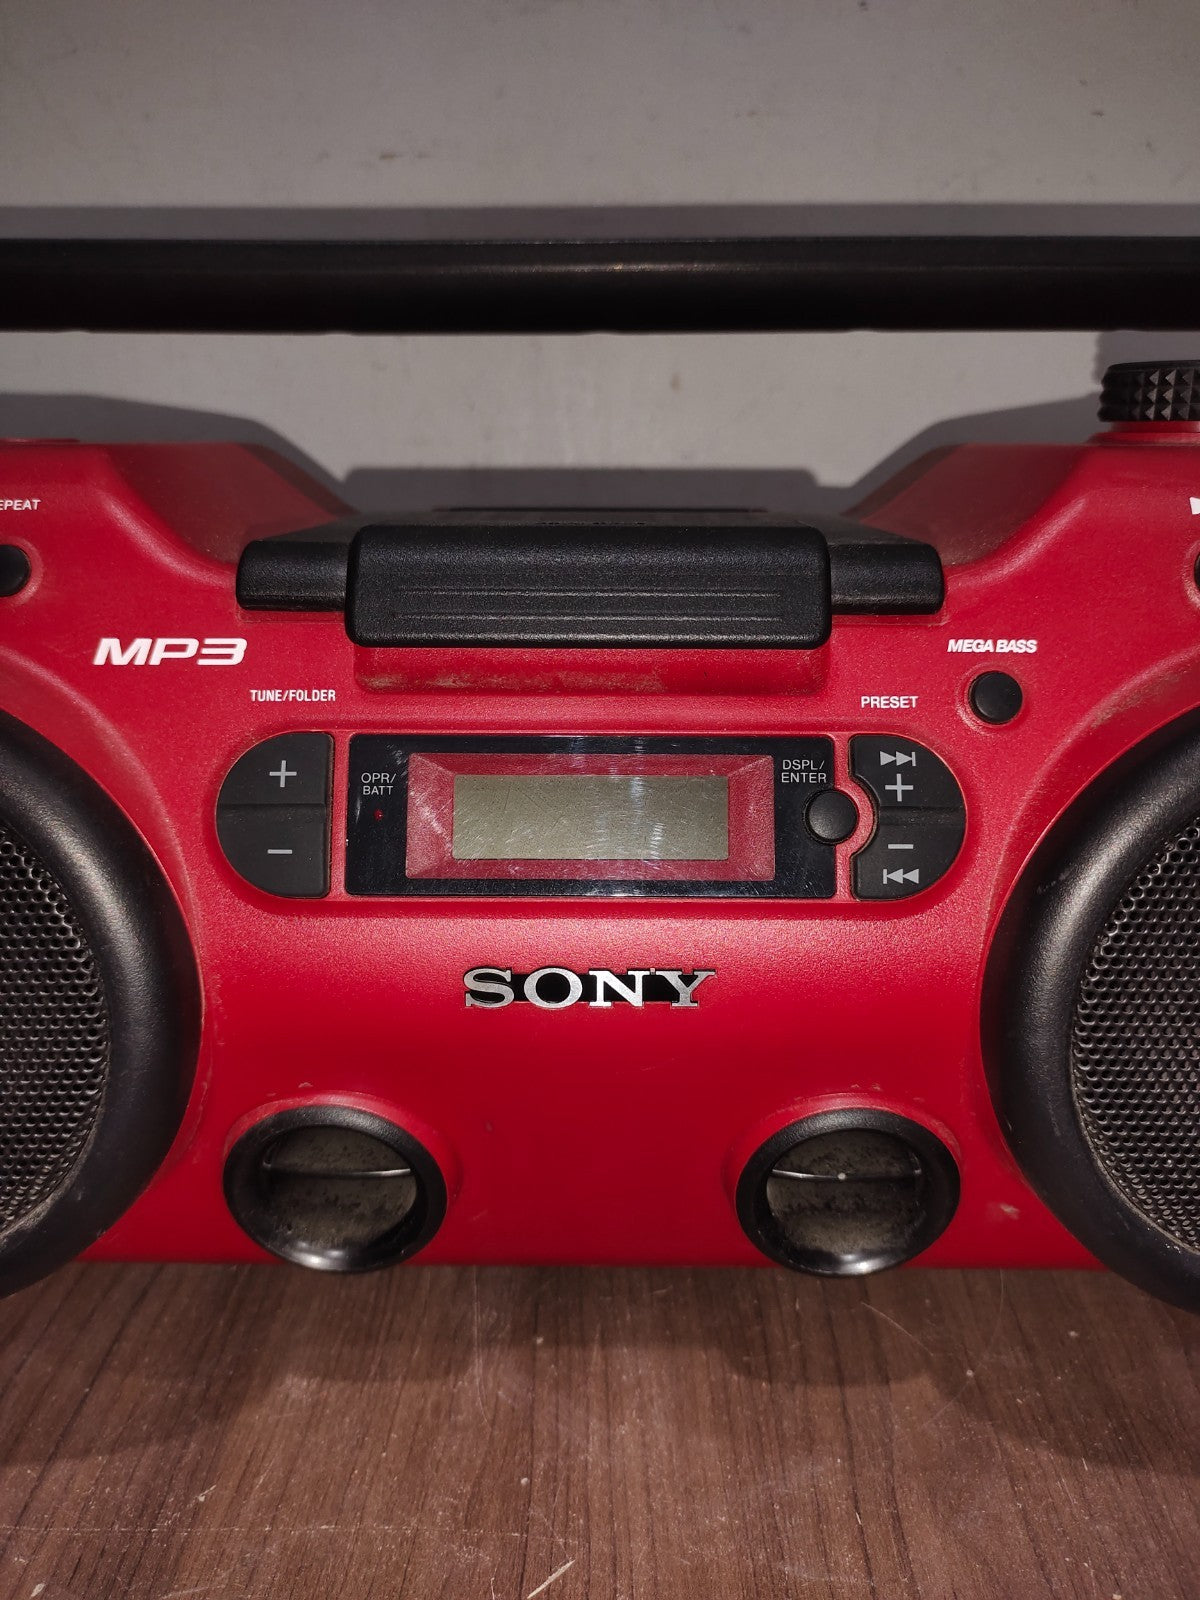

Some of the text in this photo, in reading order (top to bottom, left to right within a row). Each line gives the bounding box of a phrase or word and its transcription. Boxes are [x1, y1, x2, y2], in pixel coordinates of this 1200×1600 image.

[93, 637, 248, 666] MP3
[947, 639, 1038, 653] MEGA BASS
[250, 689, 336, 702] TUNE/FOLDER
[860, 695, 919, 709] PRESET
[782, 759, 825, 771] DSPL/
[361, 772, 397, 784] OPR/
[781, 772, 827, 784] ENTER
[362, 785, 394, 796] BATT
[464, 967, 716, 1009] SONY
